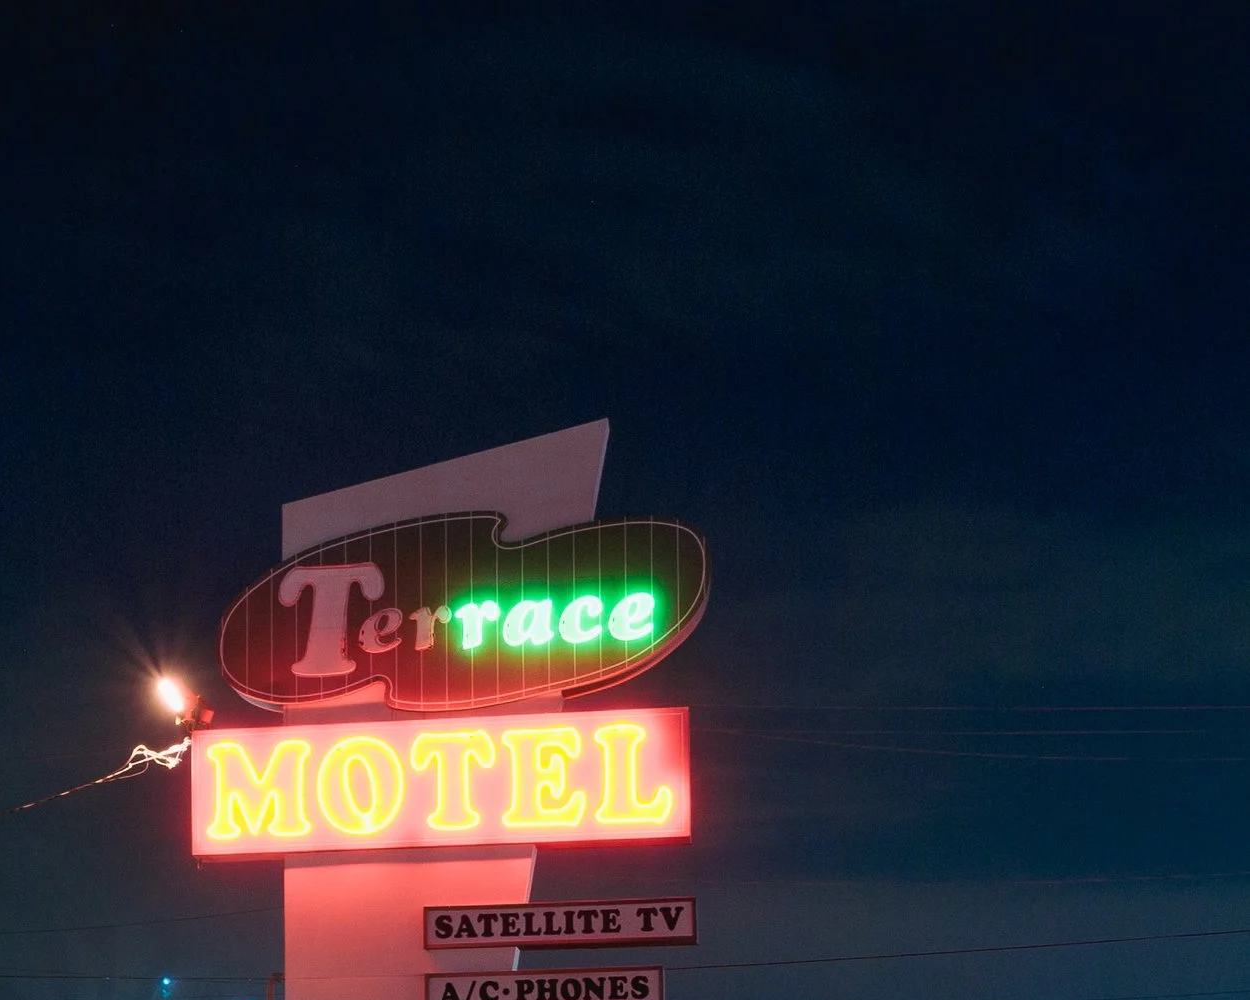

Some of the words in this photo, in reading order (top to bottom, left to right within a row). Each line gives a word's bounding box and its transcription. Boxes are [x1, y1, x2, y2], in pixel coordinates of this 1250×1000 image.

[277, 562, 657, 678] Terrace
[205, 723, 674, 841] MOTEL
[434, 908, 621, 939] SATELLITE
[636, 906, 684, 931] TV
